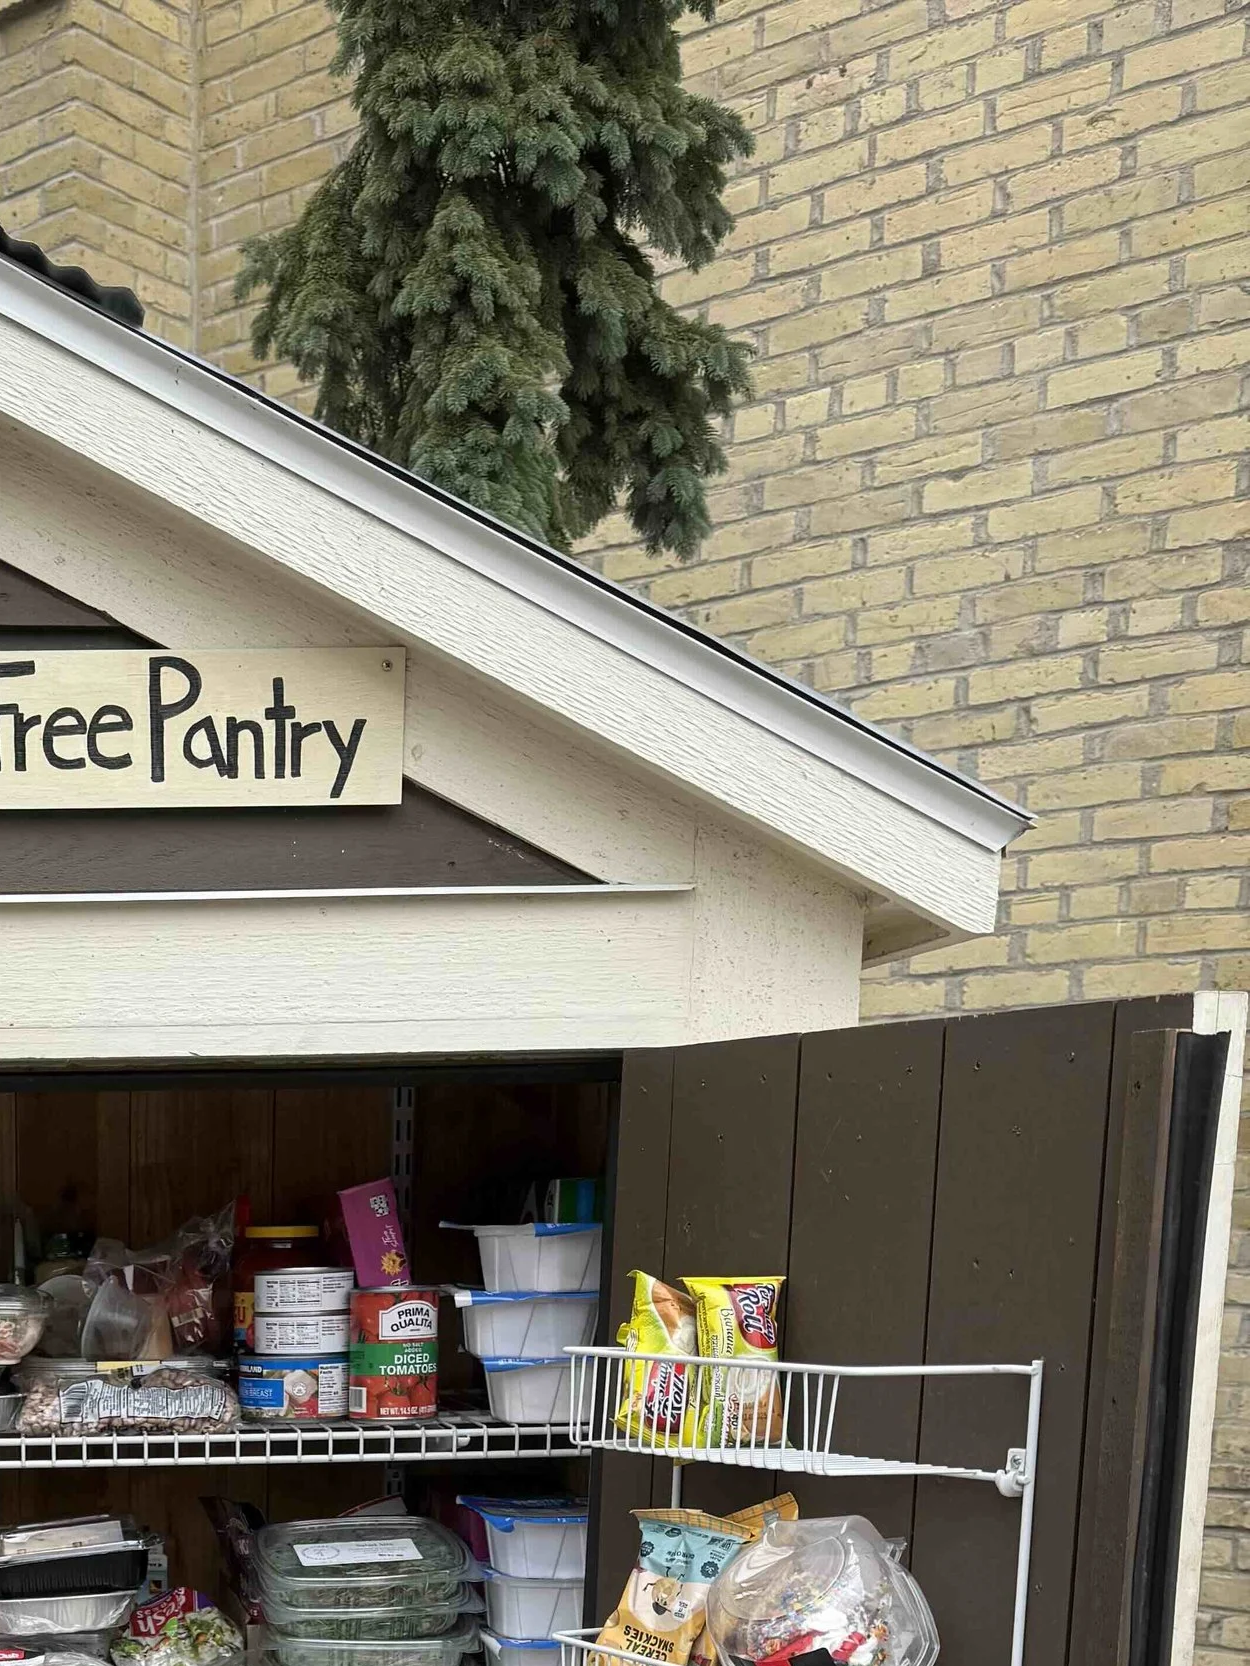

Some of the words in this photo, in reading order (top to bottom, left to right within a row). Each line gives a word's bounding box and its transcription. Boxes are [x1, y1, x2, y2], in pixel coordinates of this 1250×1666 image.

[149, 656, 366, 798] Pantry
[398, 1306, 430, 1319] PRIMA
[735, 1289, 763, 1336] Roll
[391, 1318, 432, 1332] QUALITA
[721, 1309, 734, 1355] Banana
[379, 1363, 437, 1375] TOMATOES
[394, 1354, 429, 1364] DICED
[623, 1626, 675, 1652] SNACKIES
[626, 1639, 667, 1662] CEREAL
